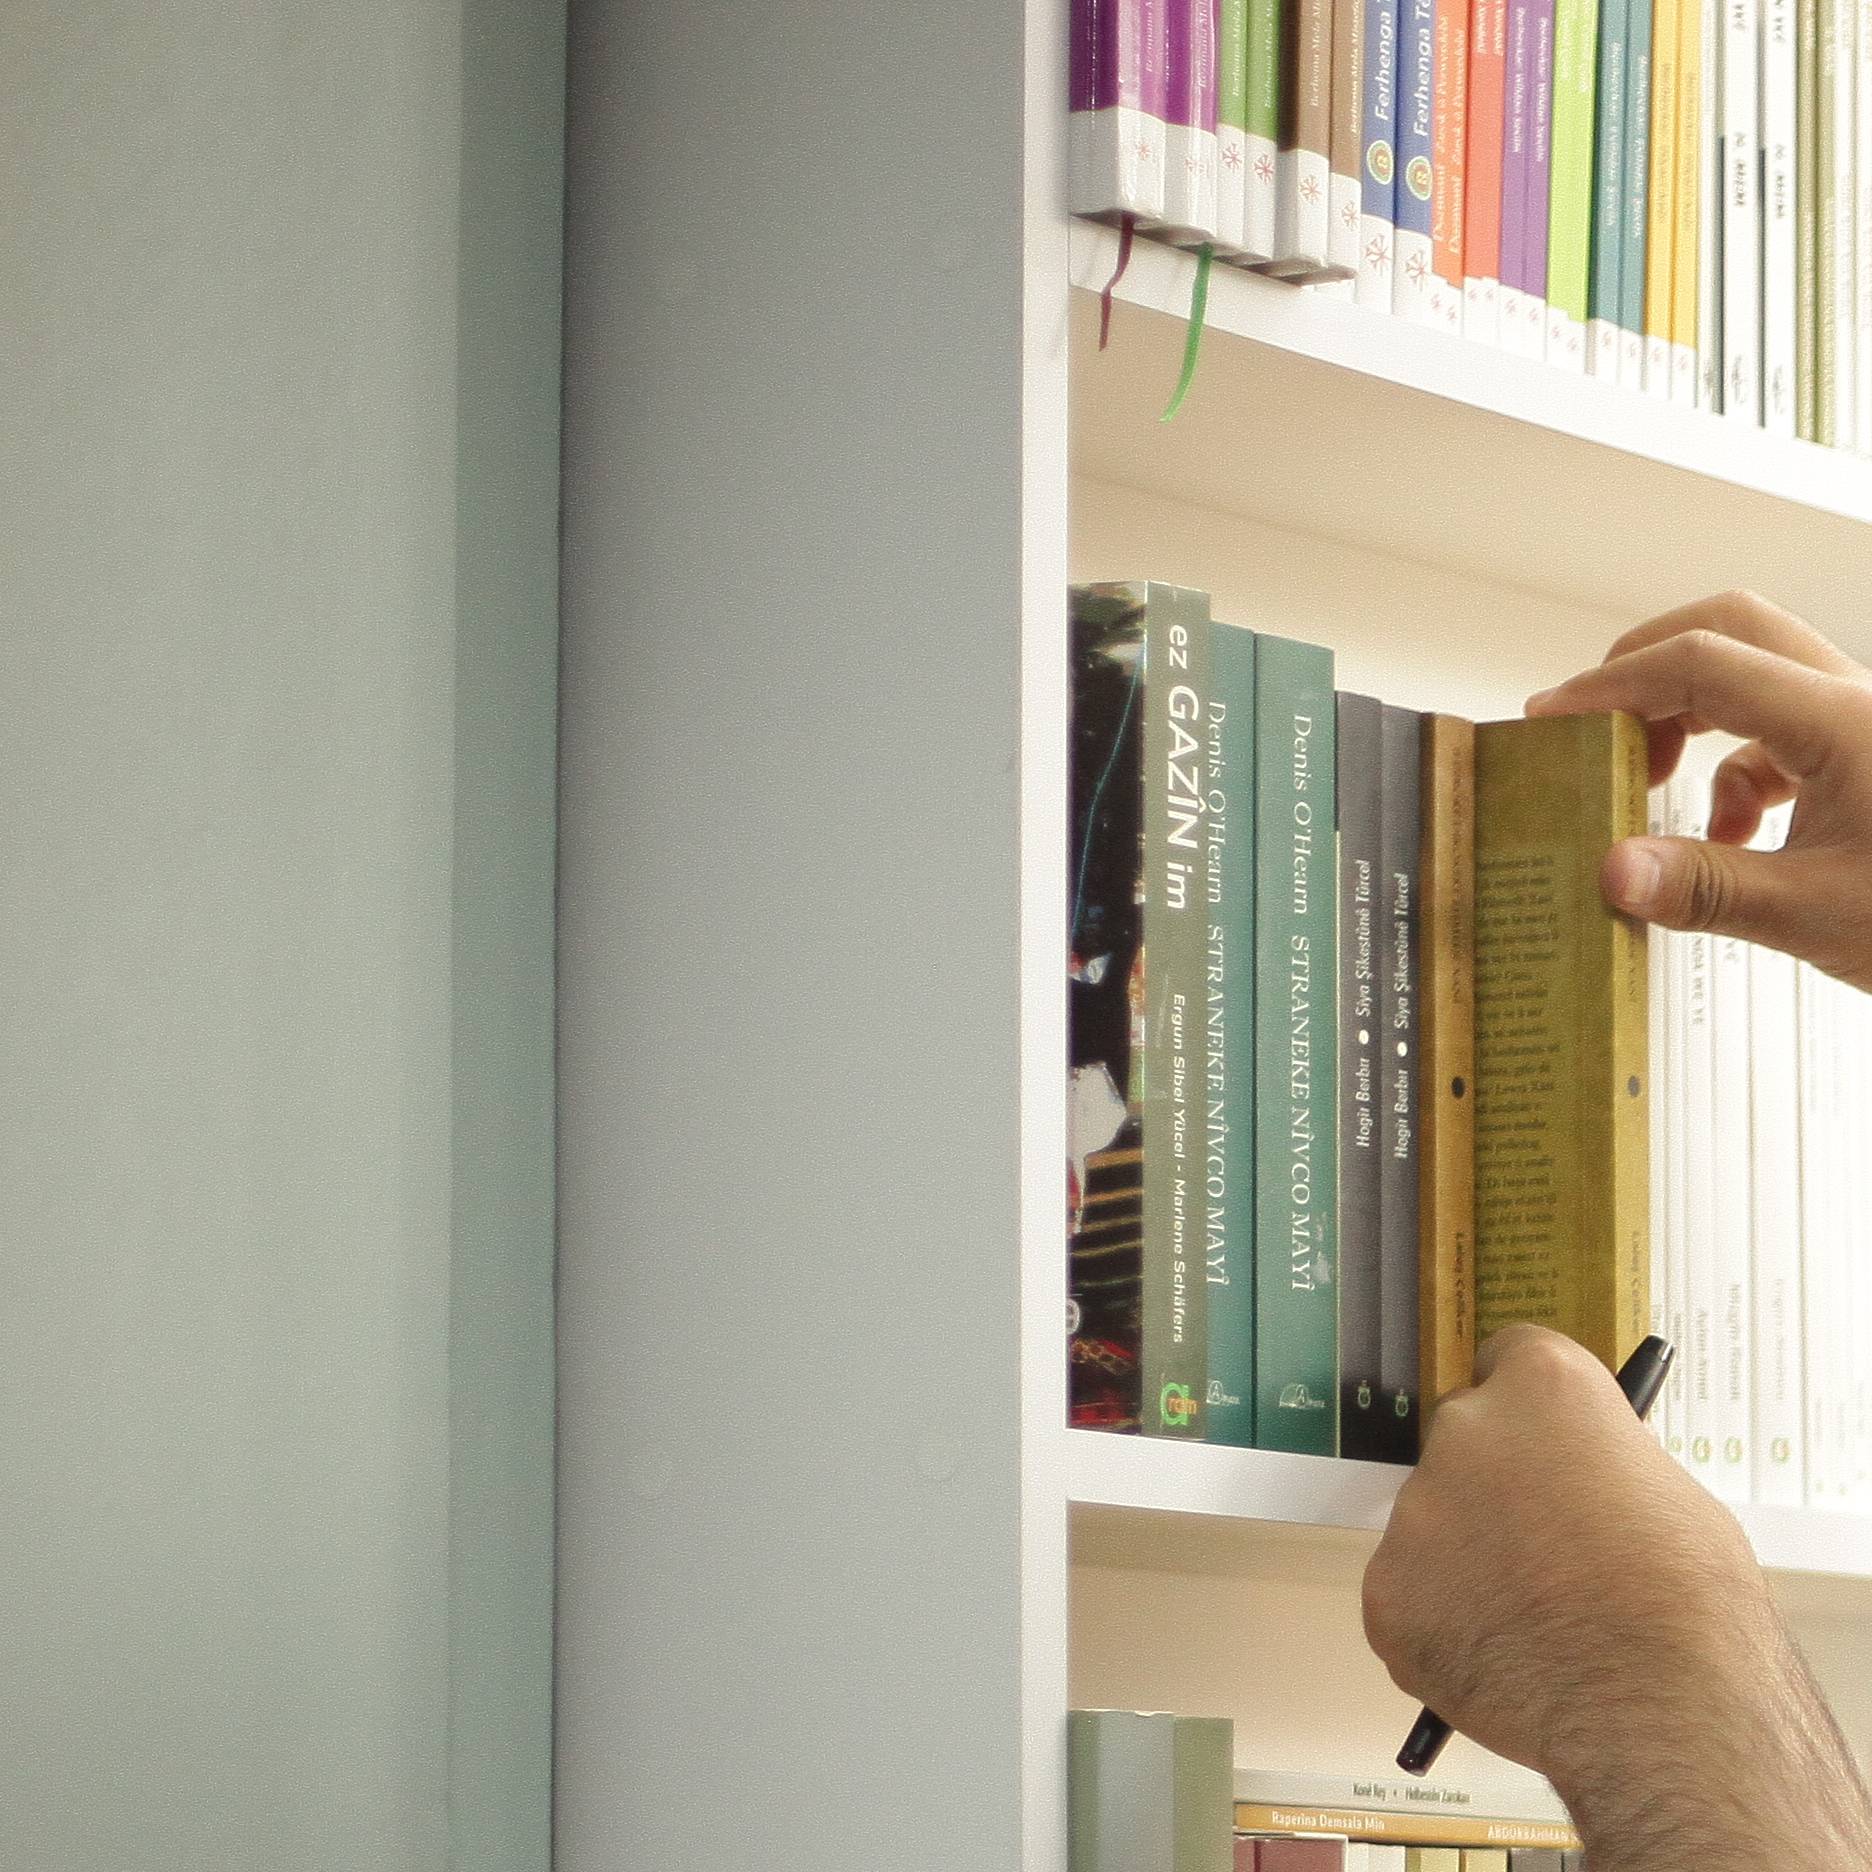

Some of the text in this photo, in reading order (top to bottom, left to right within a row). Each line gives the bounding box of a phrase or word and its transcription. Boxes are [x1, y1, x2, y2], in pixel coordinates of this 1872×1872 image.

[1373, 11, 1395, 121] Ferhenga
[1412, 27, 1434, 137] Ferhenga
[1166, 624, 1207, 910] ez GAZÎN im
[1170, 994, 1187, 1051] Ergun
[1205, 701, 1231, 1287] Denis O'Hearn STRANEKE NÎVCO MAYÎ
[1290, 714, 1316, 1292] Denis O'Hearn STRANEKE NÎVCO MAYÎ
[1173, 1056, 1187, 1103] Sibel
[1173, 1179, 1187, 1254] Marlene
